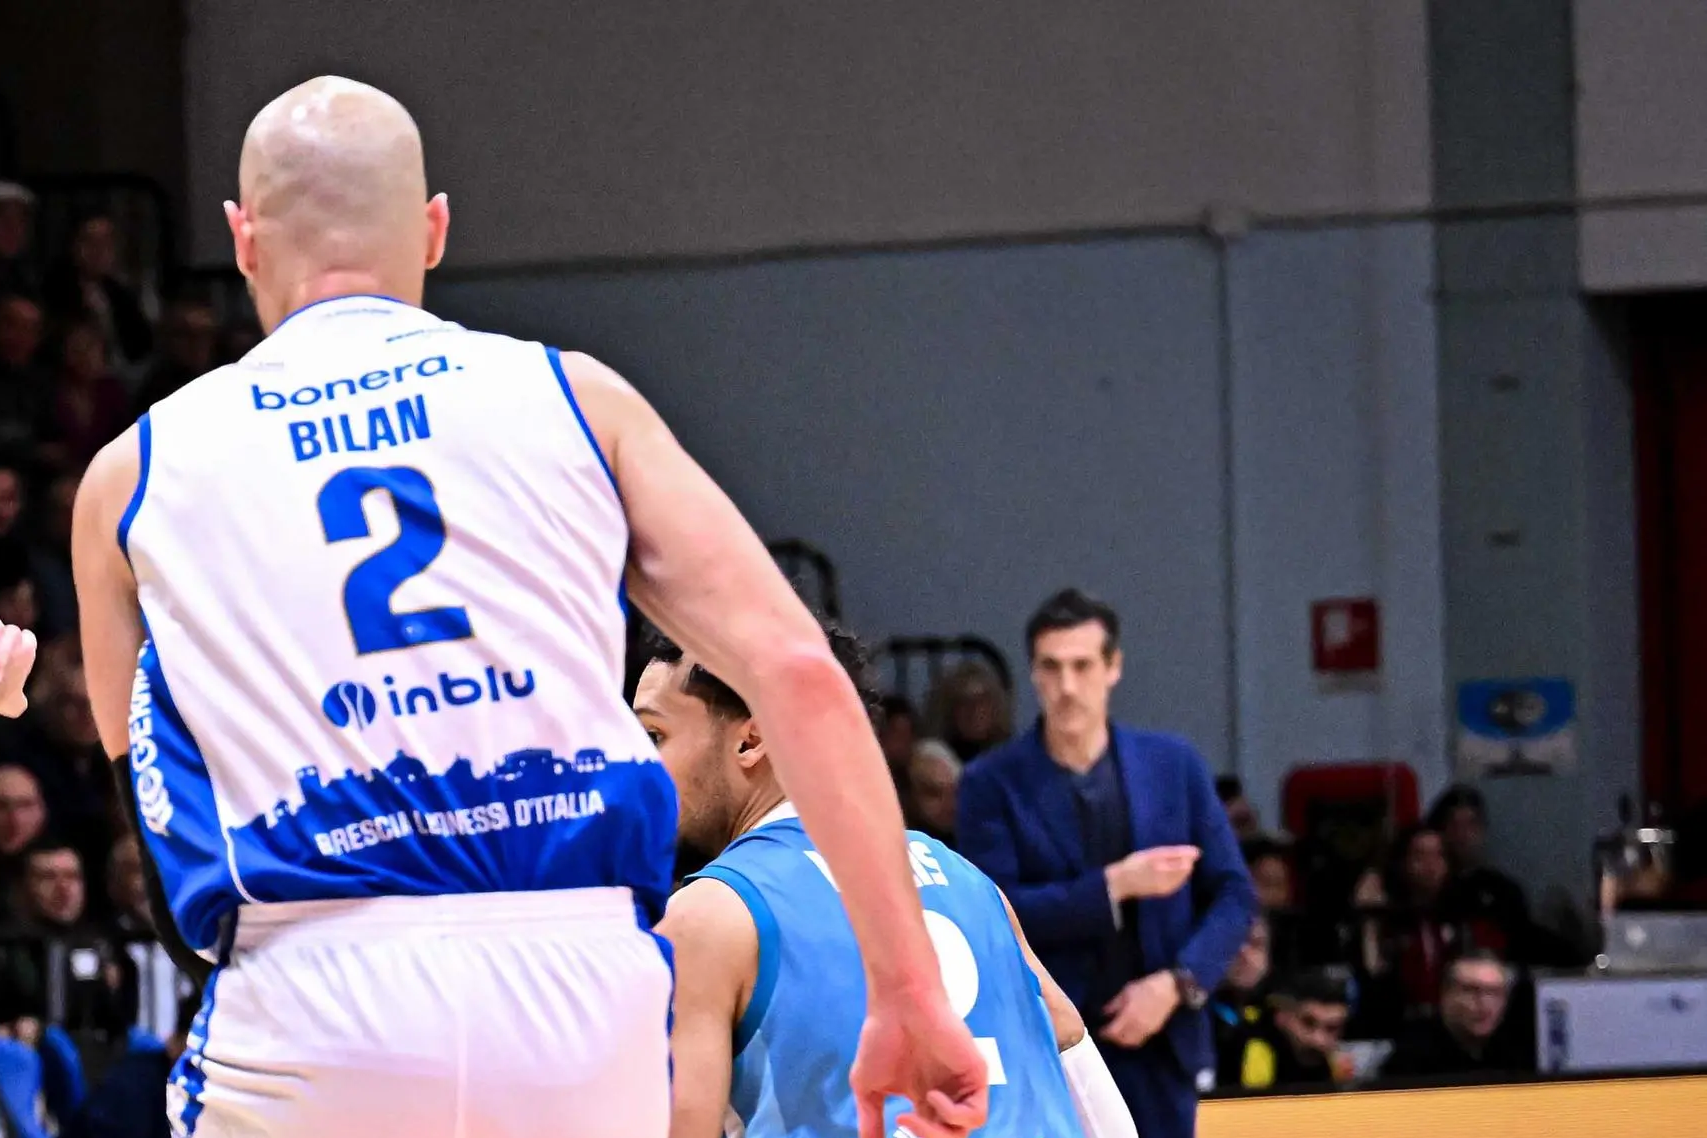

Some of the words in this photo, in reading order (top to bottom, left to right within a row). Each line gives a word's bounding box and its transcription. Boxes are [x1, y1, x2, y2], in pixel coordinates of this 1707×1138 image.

[251, 354, 464, 411] bonera.
[287, 393, 433, 463] BILAN
[317, 465, 475, 657] 2
[384, 665, 536, 718] inblu
